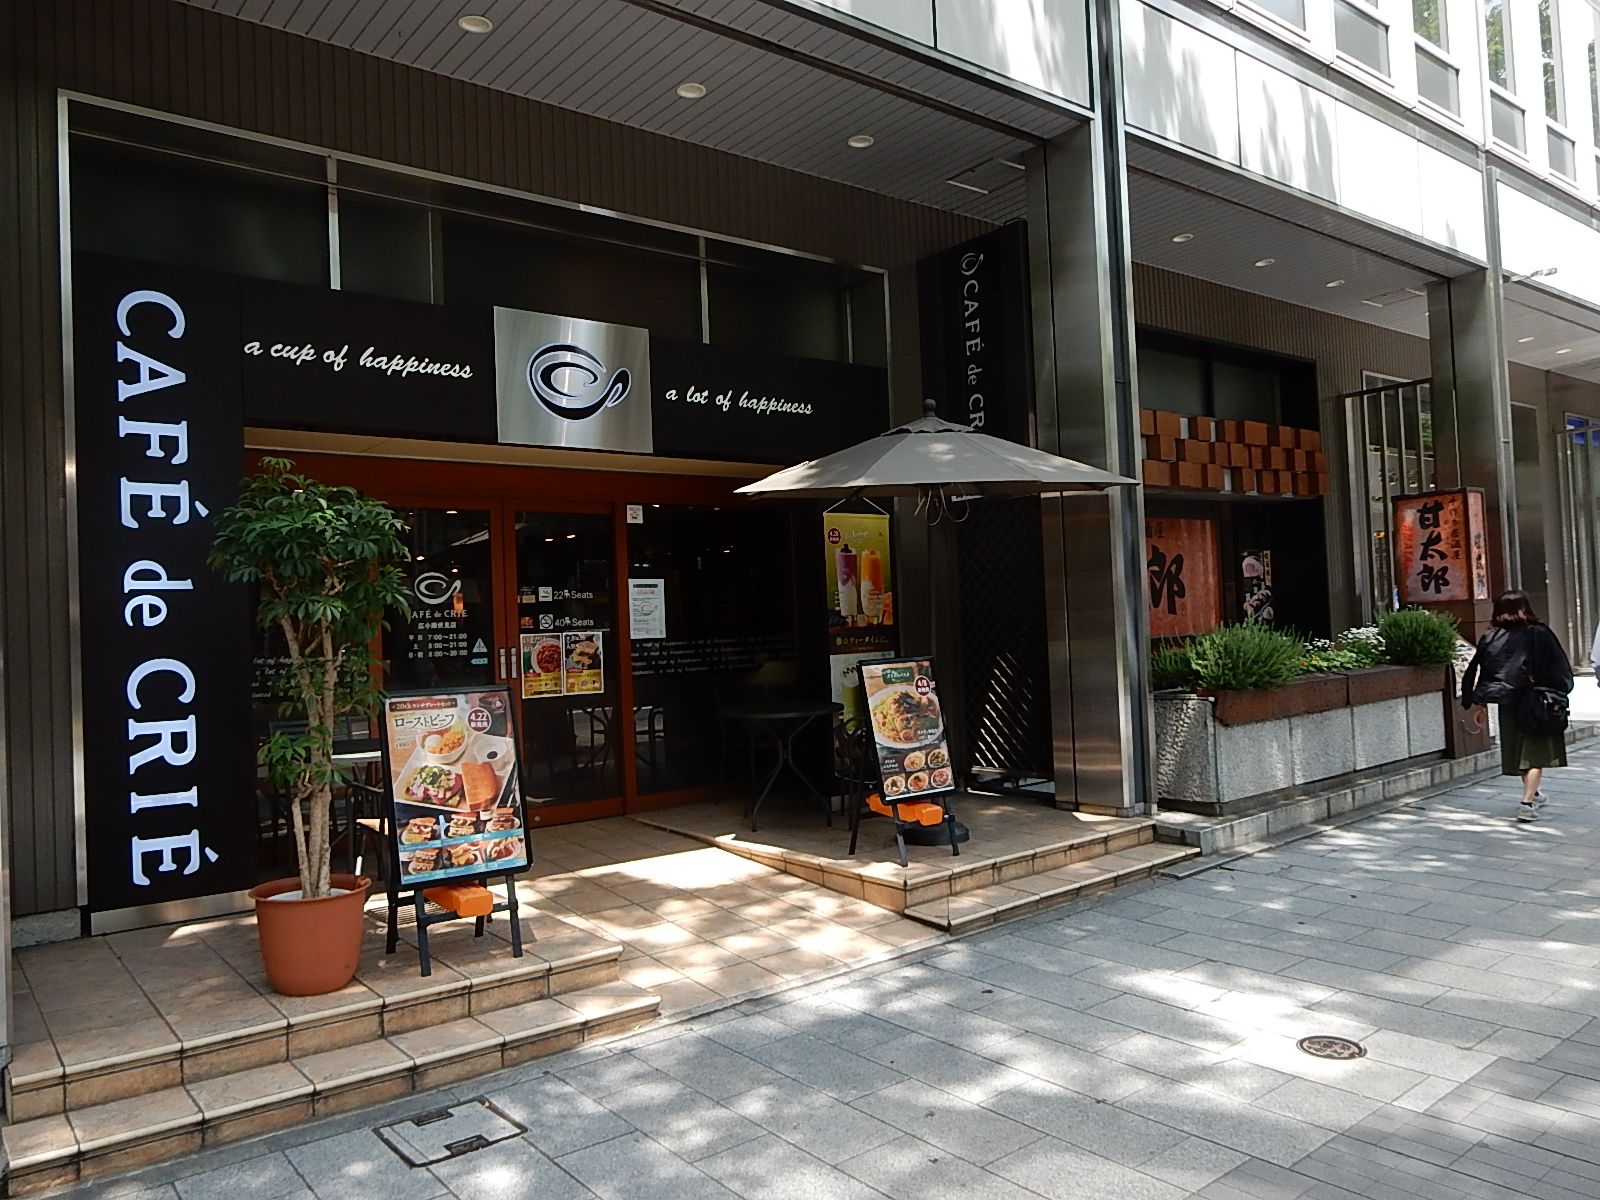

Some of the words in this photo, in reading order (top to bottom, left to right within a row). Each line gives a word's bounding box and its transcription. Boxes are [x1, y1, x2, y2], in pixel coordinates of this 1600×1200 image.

[964, 279, 985, 356] CAFÉ
[243, 341, 263, 356] a
[270, 343, 317, 366] cup
[322, 345, 349, 371] of
[359, 346, 474, 379] happiness
[967, 364, 983, 386] de
[116, 289, 209, 528] CAFÉ
[665, 388, 678, 400] a
[686, 385, 709, 404] lot
[715, 390, 733, 411] of
[738, 391, 814, 415] happiness
[969, 393, 985, 432] CR
[1416, 500, 1450, 595] 甘太郎
[123, 559, 194, 627] de
[553, 591, 563, 600] 22
[571, 591, 594, 599] Seats
[555, 618, 565, 627] 40
[571, 618, 595, 627] Seats
[394, 713, 455, 731] ローストビーフ
[469, 712, 488, 721] 4.22
[126, 657, 219, 886] CRIÉ
